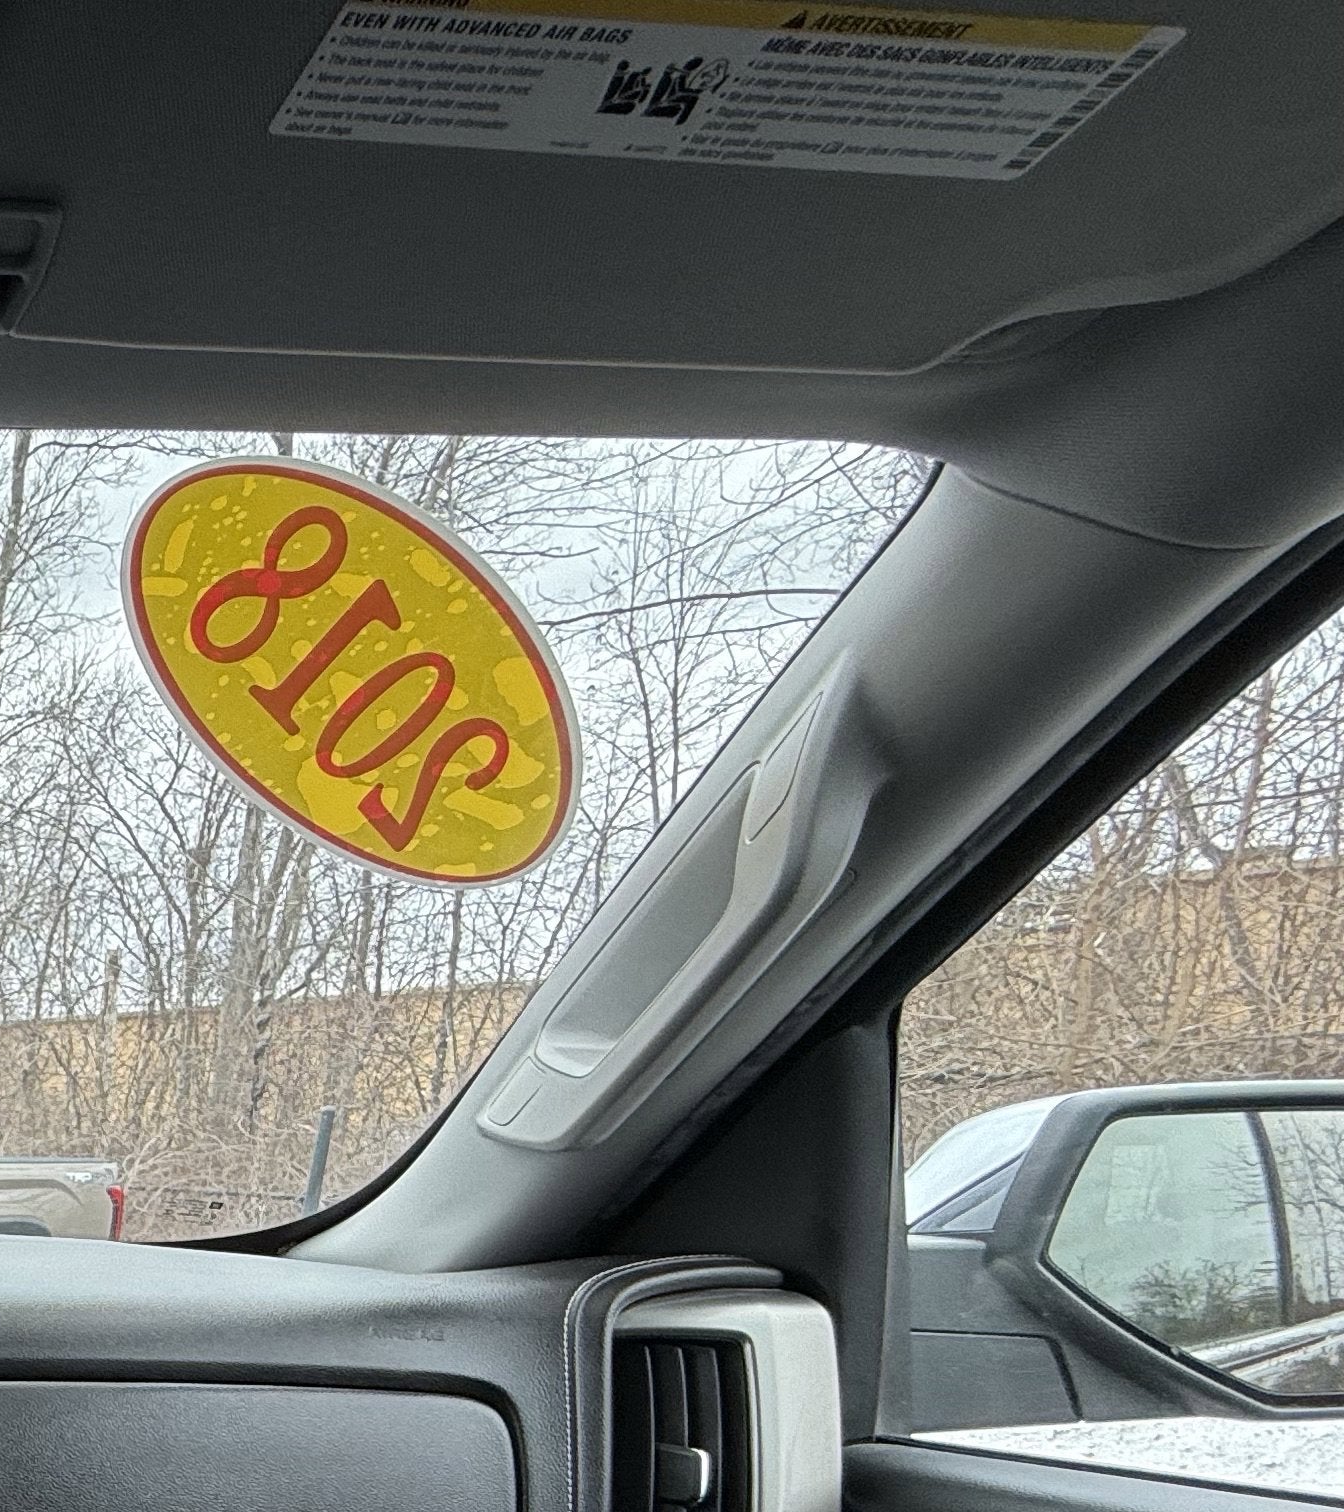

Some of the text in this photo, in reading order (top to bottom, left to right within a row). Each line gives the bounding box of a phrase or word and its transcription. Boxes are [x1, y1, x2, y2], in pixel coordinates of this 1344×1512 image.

[340, 11, 633, 44] EVEN WITH ADVANCED AIR BAGS
[810, 12, 973, 38] AVERTISSEMENT
[805, 41, 851, 57] AVEC
